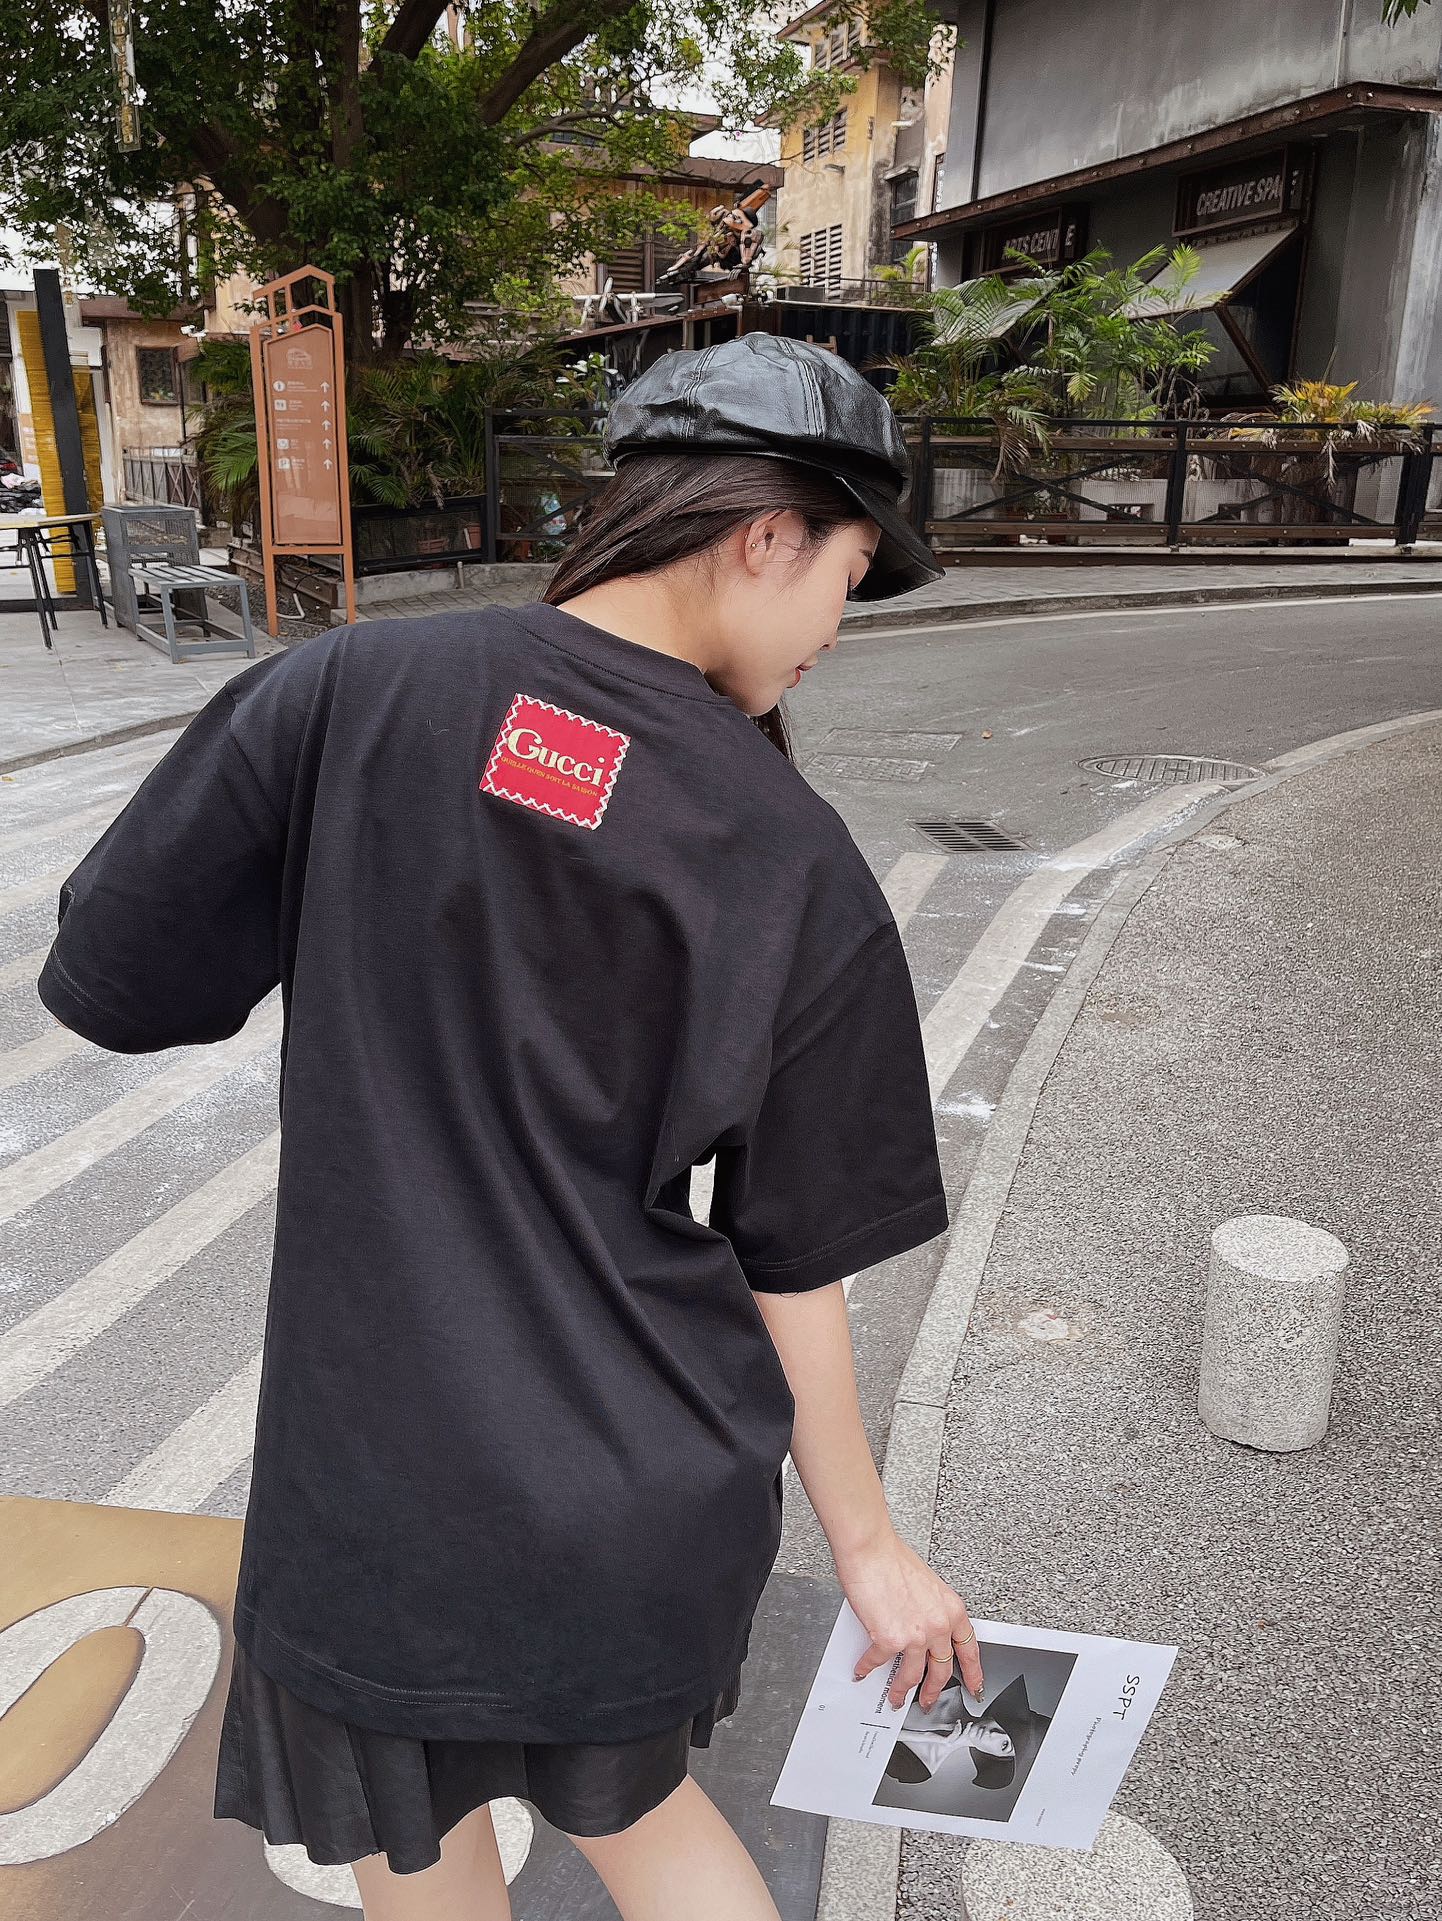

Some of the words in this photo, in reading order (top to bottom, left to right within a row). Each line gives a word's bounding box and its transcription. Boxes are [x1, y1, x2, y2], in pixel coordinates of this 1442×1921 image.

[1196, 180, 1256, 216] CREATIVE
[1030, 224, 1075, 255] CENTE
[507, 727, 605, 788] Gucci
[874, 1687, 893, 1714] moment
[1112, 1673, 1141, 1721] SSPT
